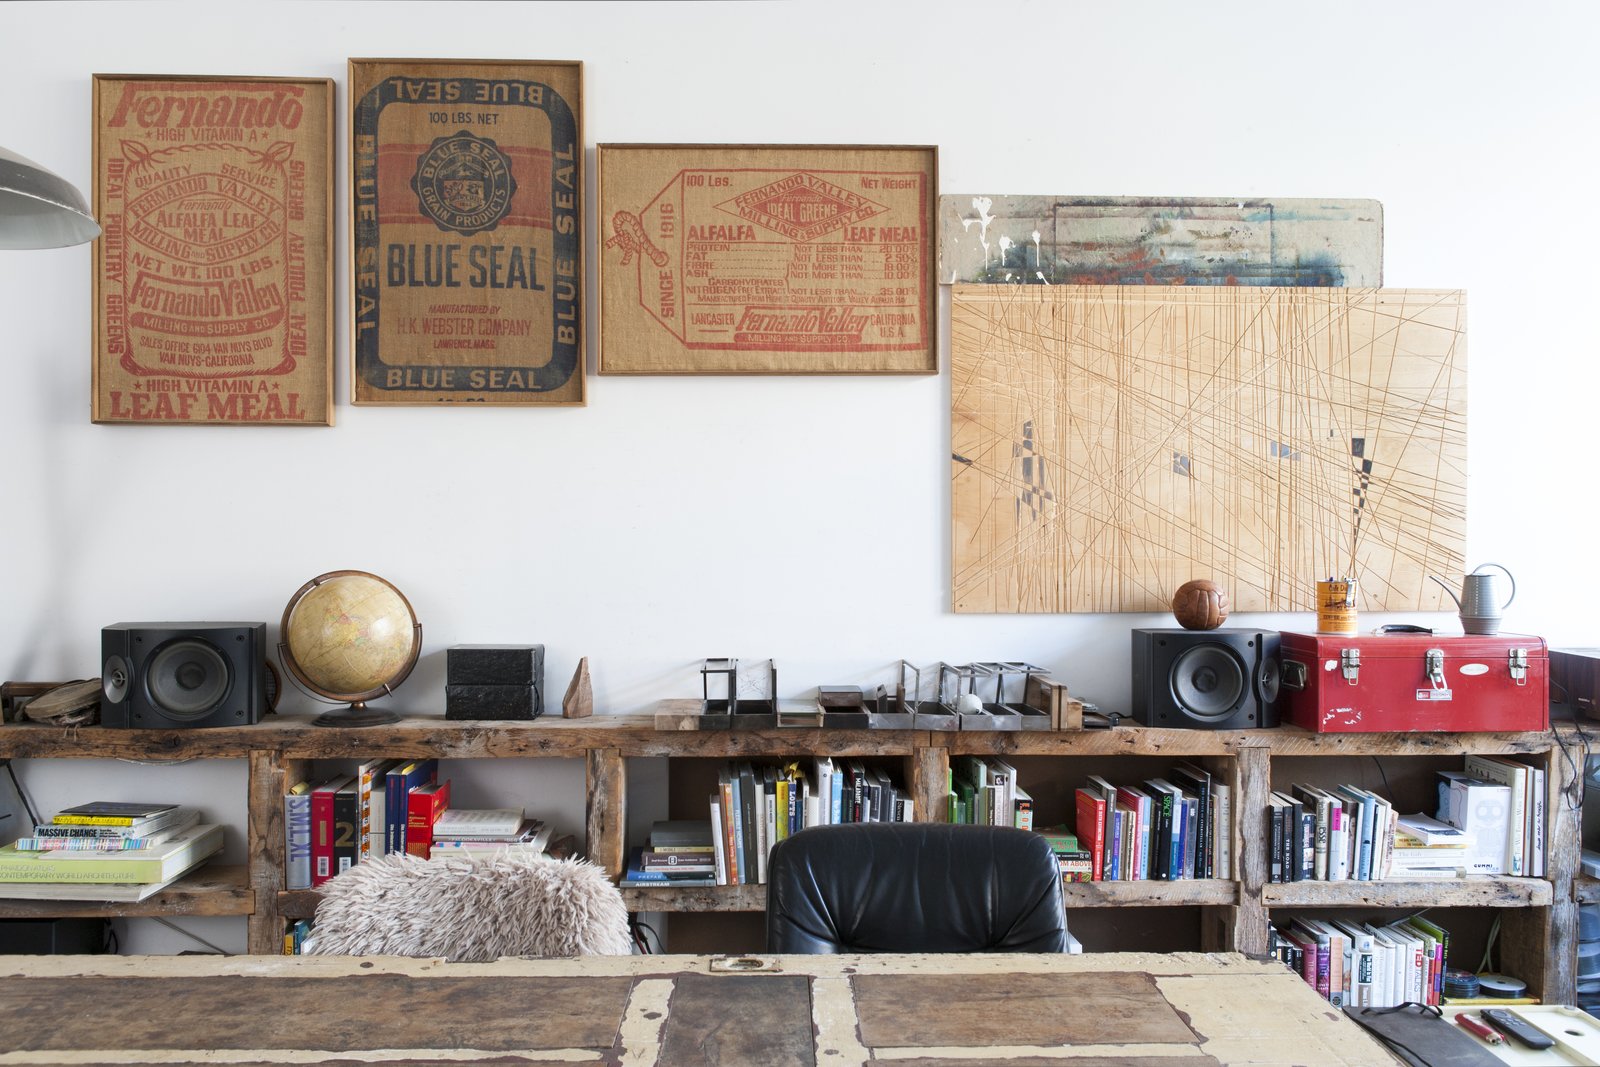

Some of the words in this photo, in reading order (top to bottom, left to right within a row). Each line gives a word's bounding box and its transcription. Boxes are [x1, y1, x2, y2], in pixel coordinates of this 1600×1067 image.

[389, 80, 463, 101] SEAL
[475, 82, 544, 104] BLUE
[107, 82, 304, 129] Fernando
[429, 112, 448, 124] 100
[451, 112, 476, 124] LBS.
[478, 113, 499, 125] NET
[156, 128, 186, 142] HIGH
[191, 128, 243, 142] VITAMIN
[249, 129, 257, 142] A
[423, 141, 460, 179] BLUE
[470, 142, 505, 179] SEAL
[107, 158, 125, 202] IDEAL
[134, 164, 191, 189] QUALITY
[220, 163, 278, 189] SERVICE
[356, 134, 376, 223] BLUE
[686, 175, 704, 187] 100
[861, 176, 880, 189] NET
[882, 177, 917, 190] WEIGHT
[128, 176, 208, 219] FERNANDO
[217, 178, 281, 214] VALLEY
[288, 160, 305, 221] GREENS
[555, 143, 575, 235] SEAL
[735, 175, 804, 208] FERNANDO
[808, 177, 865, 207] VALLEY
[156, 210, 217, 228] ALFALFA
[223, 210, 258, 228] LEAF
[423, 187, 451, 221] GRAIN
[455, 189, 506, 226] PRODUCTS
[767, 203, 796, 220] IDEAL
[801, 203, 838, 220] GREENS
[660, 203, 674, 239] 1916
[687, 225, 756, 241] ALFALFA
[843, 225, 876, 242] LEAF
[879, 226, 918, 242] MEAL
[739, 206, 799, 239] MILLING
[807, 215, 853, 237] SUPPLY
[105, 213, 123, 283] POULTRY
[130, 221, 191, 258] MILLING
[205, 236, 260, 262] SUPPLY
[183, 228, 226, 243] MEAL
[686, 244, 731, 252] PROTEIN
[794, 244, 810, 253] NOT
[816, 244, 839, 253] LESS
[841, 245, 863, 253] THAN
[686, 252, 708, 261] FAT
[794, 254, 810, 263] NOT
[816, 254, 839, 262] LESS
[840, 254, 863, 262] THAN
[132, 252, 165, 273] NET
[172, 264, 201, 279] WT.
[207, 265, 234, 280] 100
[289, 231, 306, 302] POULTRY
[387, 243, 462, 288] BLUE
[469, 245, 546, 291] SEAL
[686, 261, 716, 270] FIBRE
[791, 263, 808, 271] NOT
[812, 263, 838, 271] MORE
[686, 270, 709, 278] ASH
[791, 271, 808, 279] NOT
[812, 271, 838, 279] MORE
[840, 271, 863, 279] THAN
[128, 271, 221, 317] Fernando
[217, 278, 284, 317] Valley
[358, 246, 377, 340] SEAL
[660, 269, 674, 318] SINCE
[708, 277, 784, 286] CARBOHYDRATES
[791, 288, 808, 296] NOT
[811, 288, 832, 296] LESS
[429, 304, 488, 315] MANUFACTURED
[555, 258, 576, 345] BLUE
[106, 294, 125, 354] GREENS
[143, 317, 188, 333] MILLING
[207, 322, 248, 334] SUPPLY
[422, 317, 474, 336] WEBSTER
[478, 318, 532, 336] COMPANY
[691, 312, 735, 326] LANCASTER
[735, 306, 822, 333] Fernando
[817, 306, 871, 333] Valley
[870, 312, 916, 326] CALIFORNIA
[140, 336, 164, 350] SALES
[164, 340, 190, 352] OFFICE
[213, 342, 228, 354] VAN
[230, 340, 252, 353] NUYS
[253, 337, 274, 350] BLVD
[290, 313, 307, 356] IDEAL
[748, 335, 782, 343] MILLING
[800, 335, 833, 343] SUPPLY
[159, 351, 176, 365] VAN
[146, 379, 181, 393] HIGH
[185, 380, 253, 394] VITAMIN
[257, 380, 269, 393] A
[386, 369, 456, 389] BLUE
[469, 370, 542, 390] SEAL
[109, 391, 198, 420] LEAF
[207, 393, 305, 420] MEAL
[788, 791, 796, 817] LOFTS
[1162, 795, 1171, 817] SPACE
[38, 828, 69, 838] MASSIVE
[69, 828, 98, 838] CHANGE
[288, 799, 310, 862] S,M,L,XL
[335, 822, 354, 847] 2
[1415, 948, 1423, 967] TED
